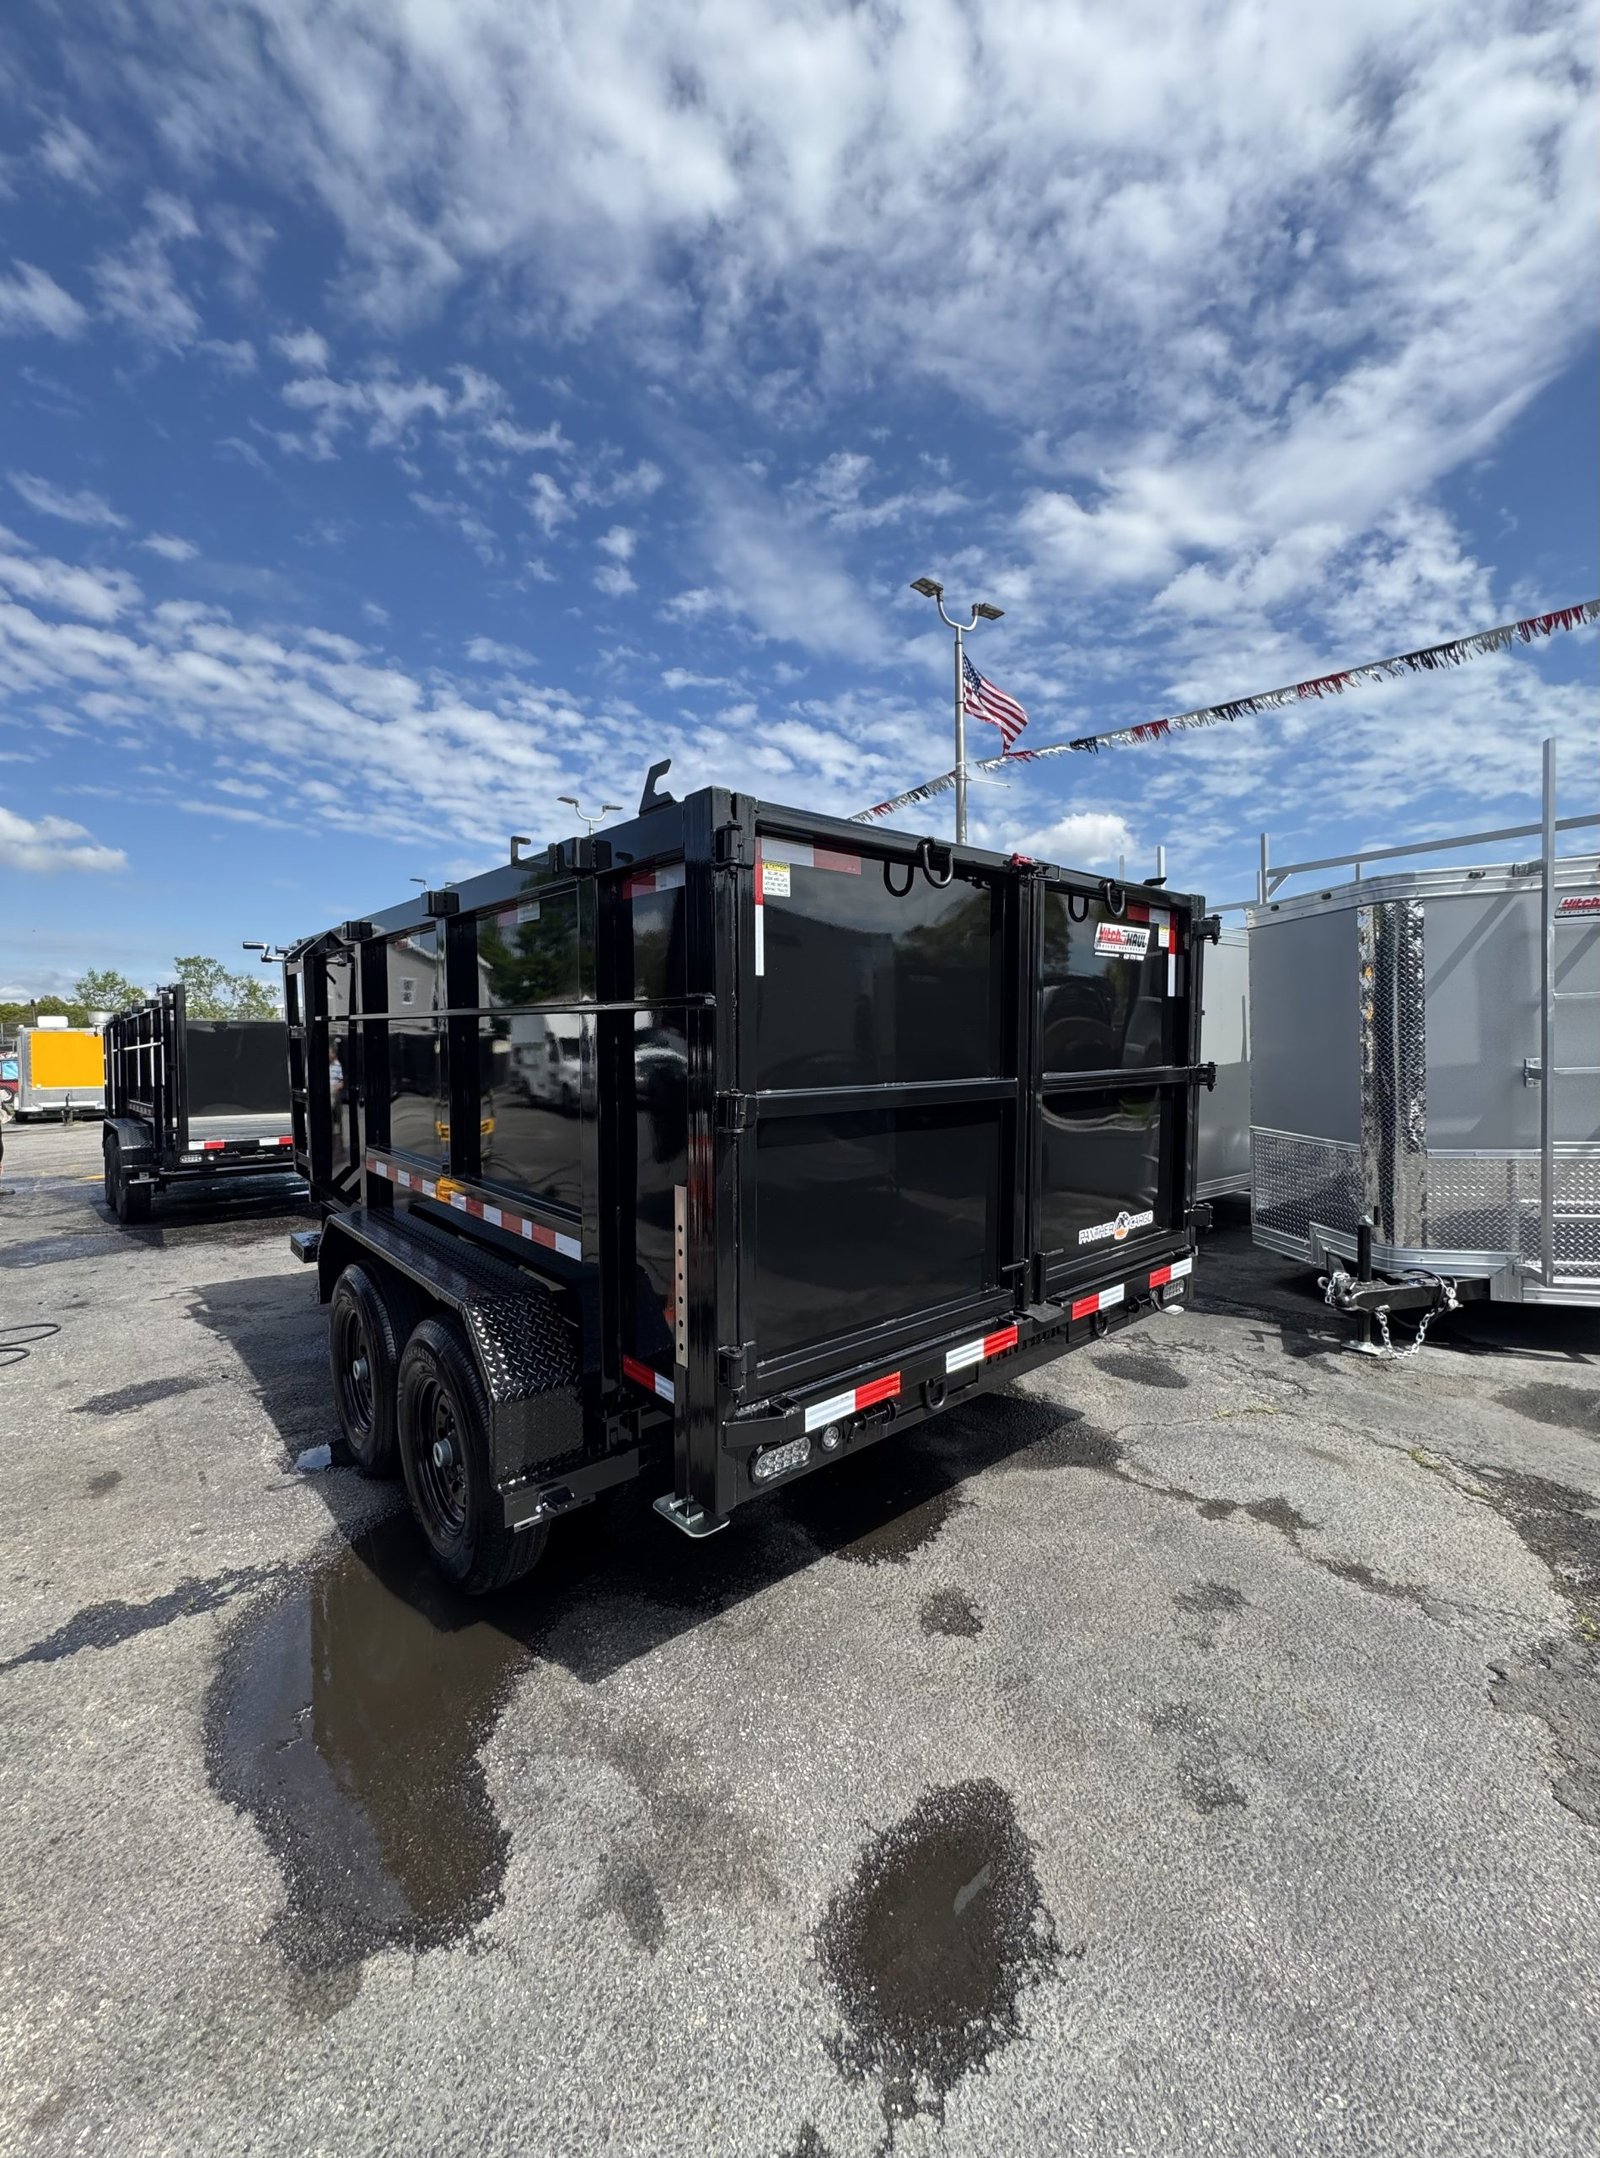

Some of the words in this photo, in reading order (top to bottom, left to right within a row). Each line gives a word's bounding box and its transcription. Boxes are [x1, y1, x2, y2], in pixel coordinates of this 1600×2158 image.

[1126, 932, 1147, 948] HAUL
[1079, 1222, 1116, 1245] PANTHER
[1129, 1210, 1154, 1230] CARGO
